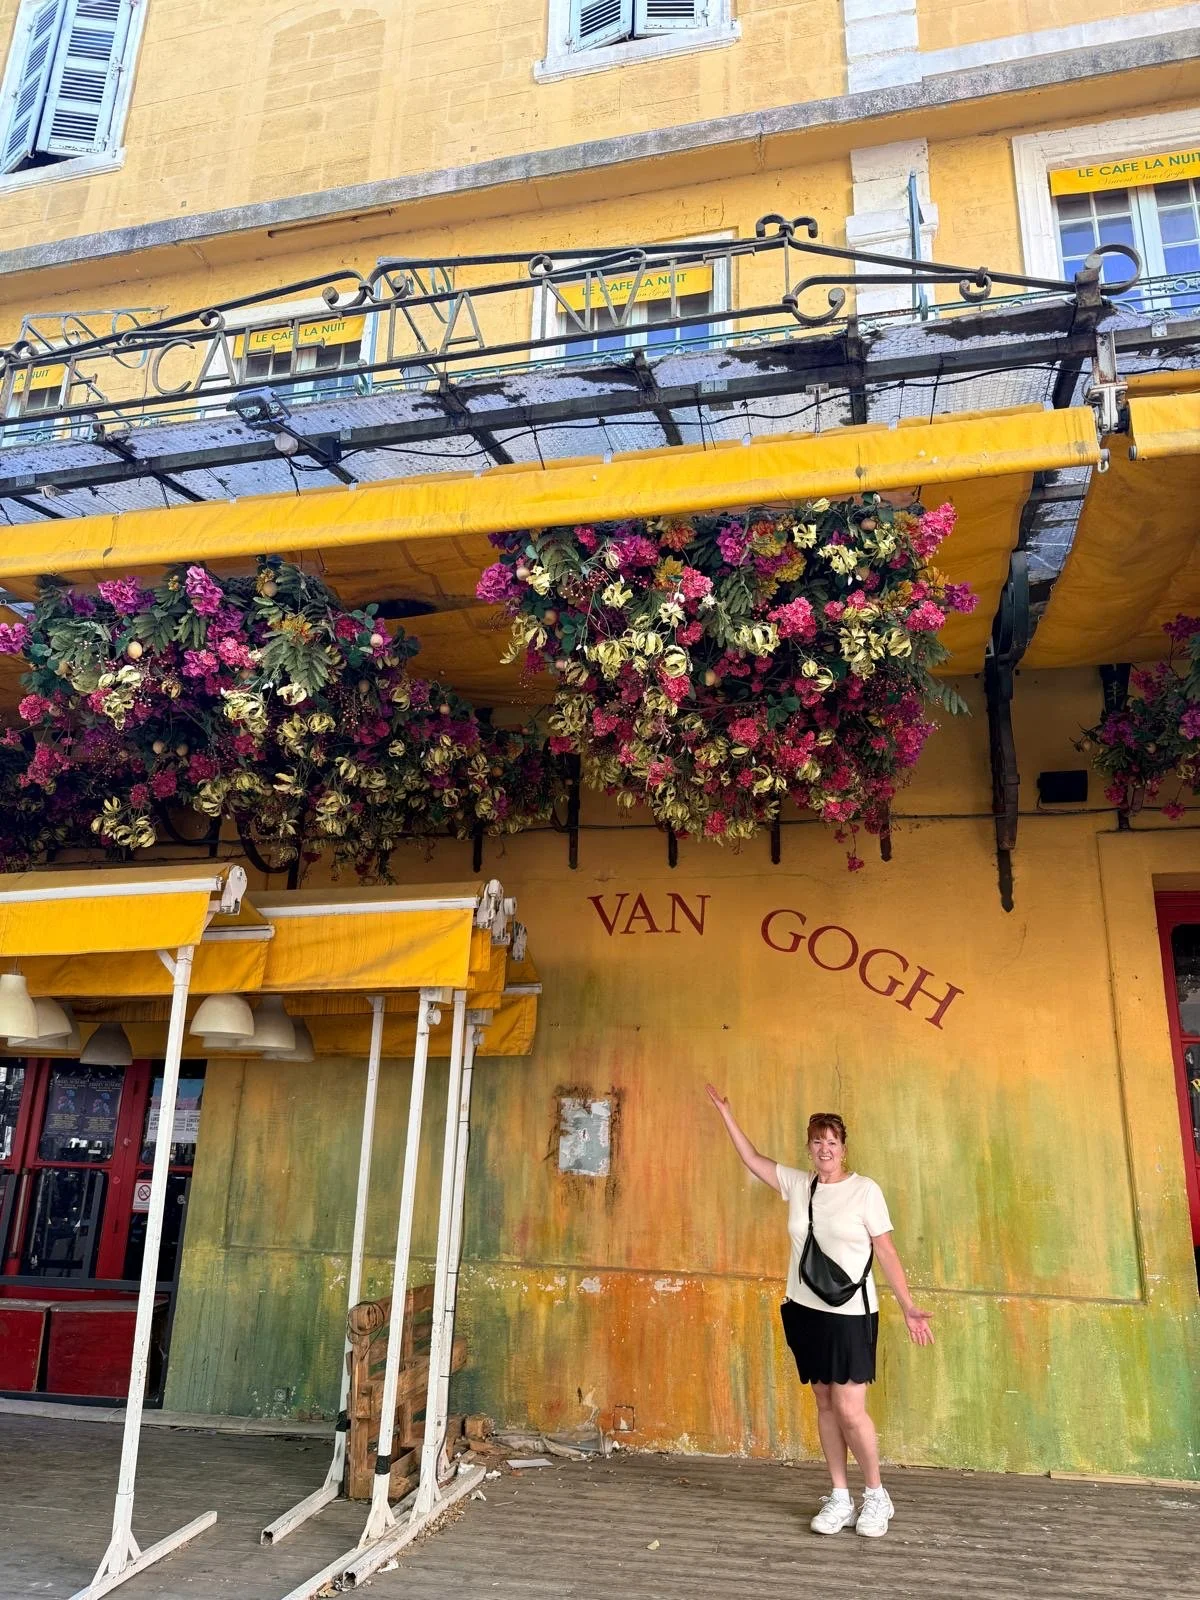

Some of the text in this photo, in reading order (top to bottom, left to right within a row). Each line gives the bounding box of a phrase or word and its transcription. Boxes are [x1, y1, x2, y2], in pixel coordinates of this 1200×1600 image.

[1078, 168, 1093, 178] LE
[1100, 162, 1139, 176] CAFE
[1145, 159, 1164, 169] LA
[256, 333, 267, 343] LE
[271, 331, 299, 341] CAF
[304, 327, 318, 336] LA
[321, 322, 346, 333] NUIT
[587, 892, 965, 1030] VAN GOGH
